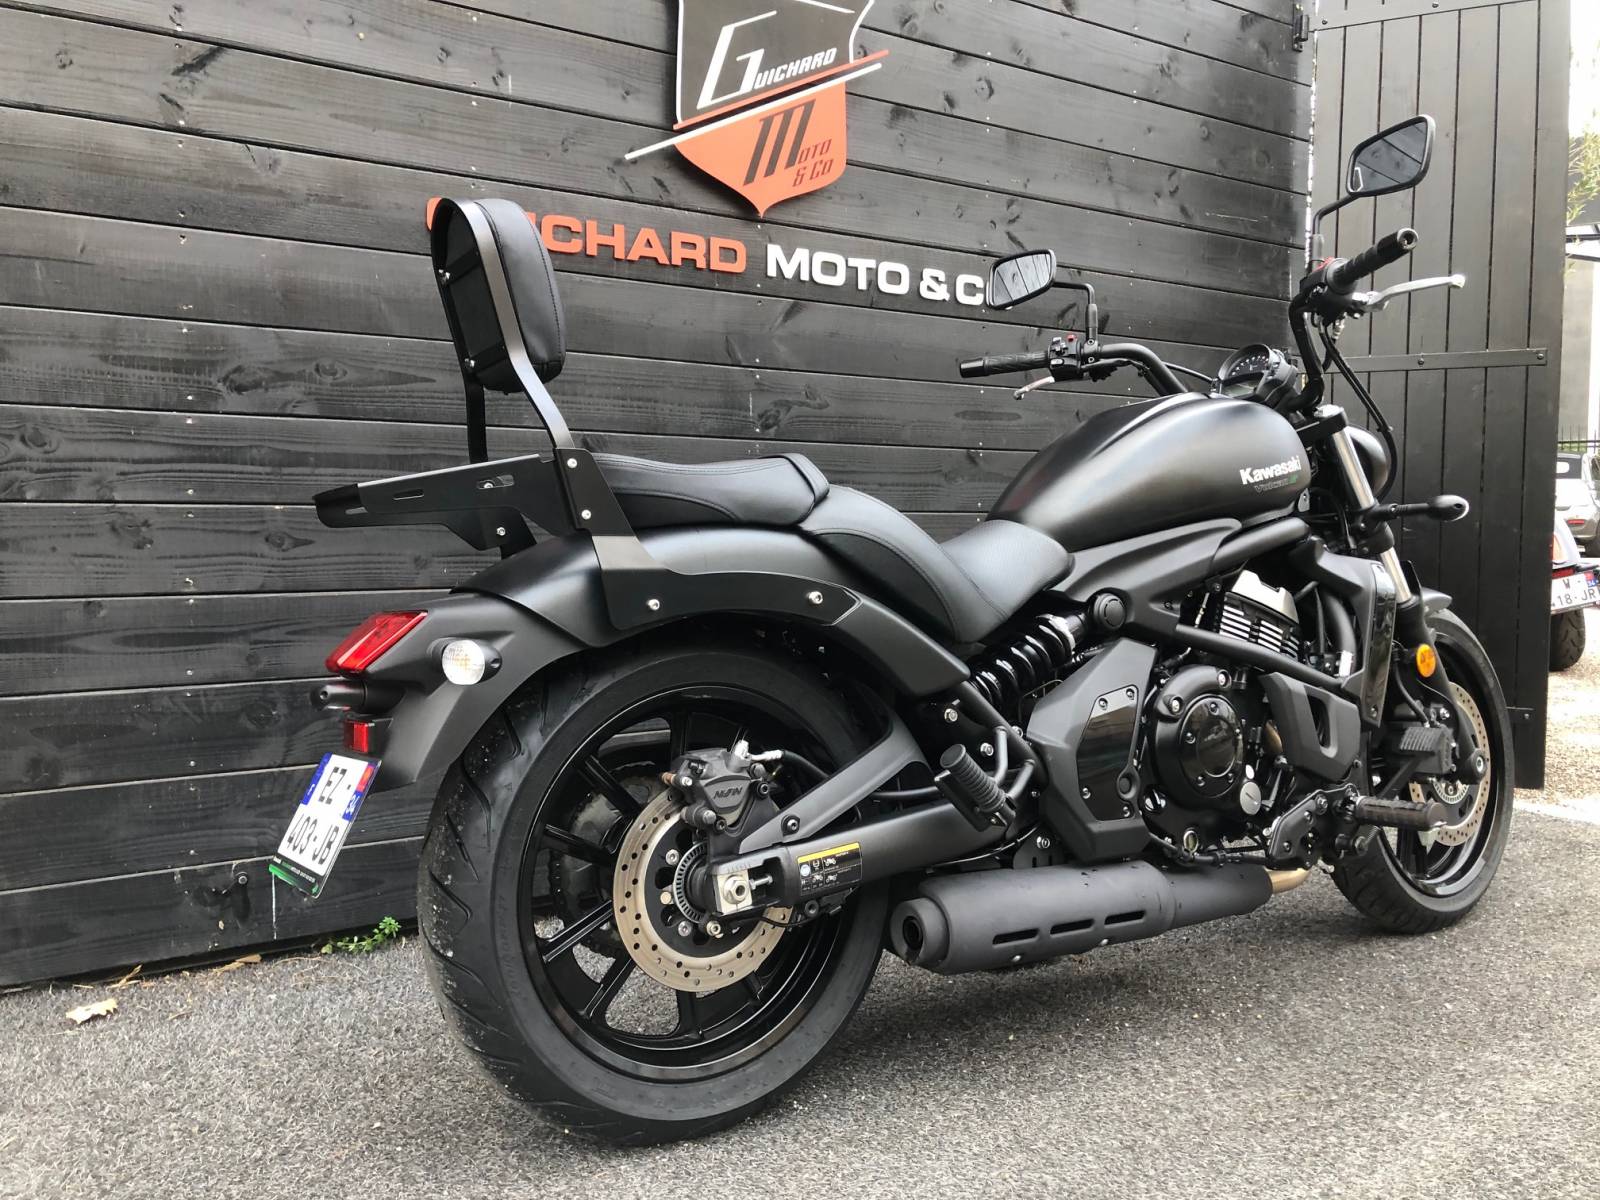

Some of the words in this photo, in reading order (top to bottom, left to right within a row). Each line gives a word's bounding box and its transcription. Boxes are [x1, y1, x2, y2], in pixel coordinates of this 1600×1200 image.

[697, 10, 837, 109] GUICHARD
[426, 197, 747, 274] CHARD
[766, 243, 910, 295] MOTO
[919, 267, 950, 302] &
[955, 273, 990, 306] C
[1240, 455, 1301, 485] Kawasaki
